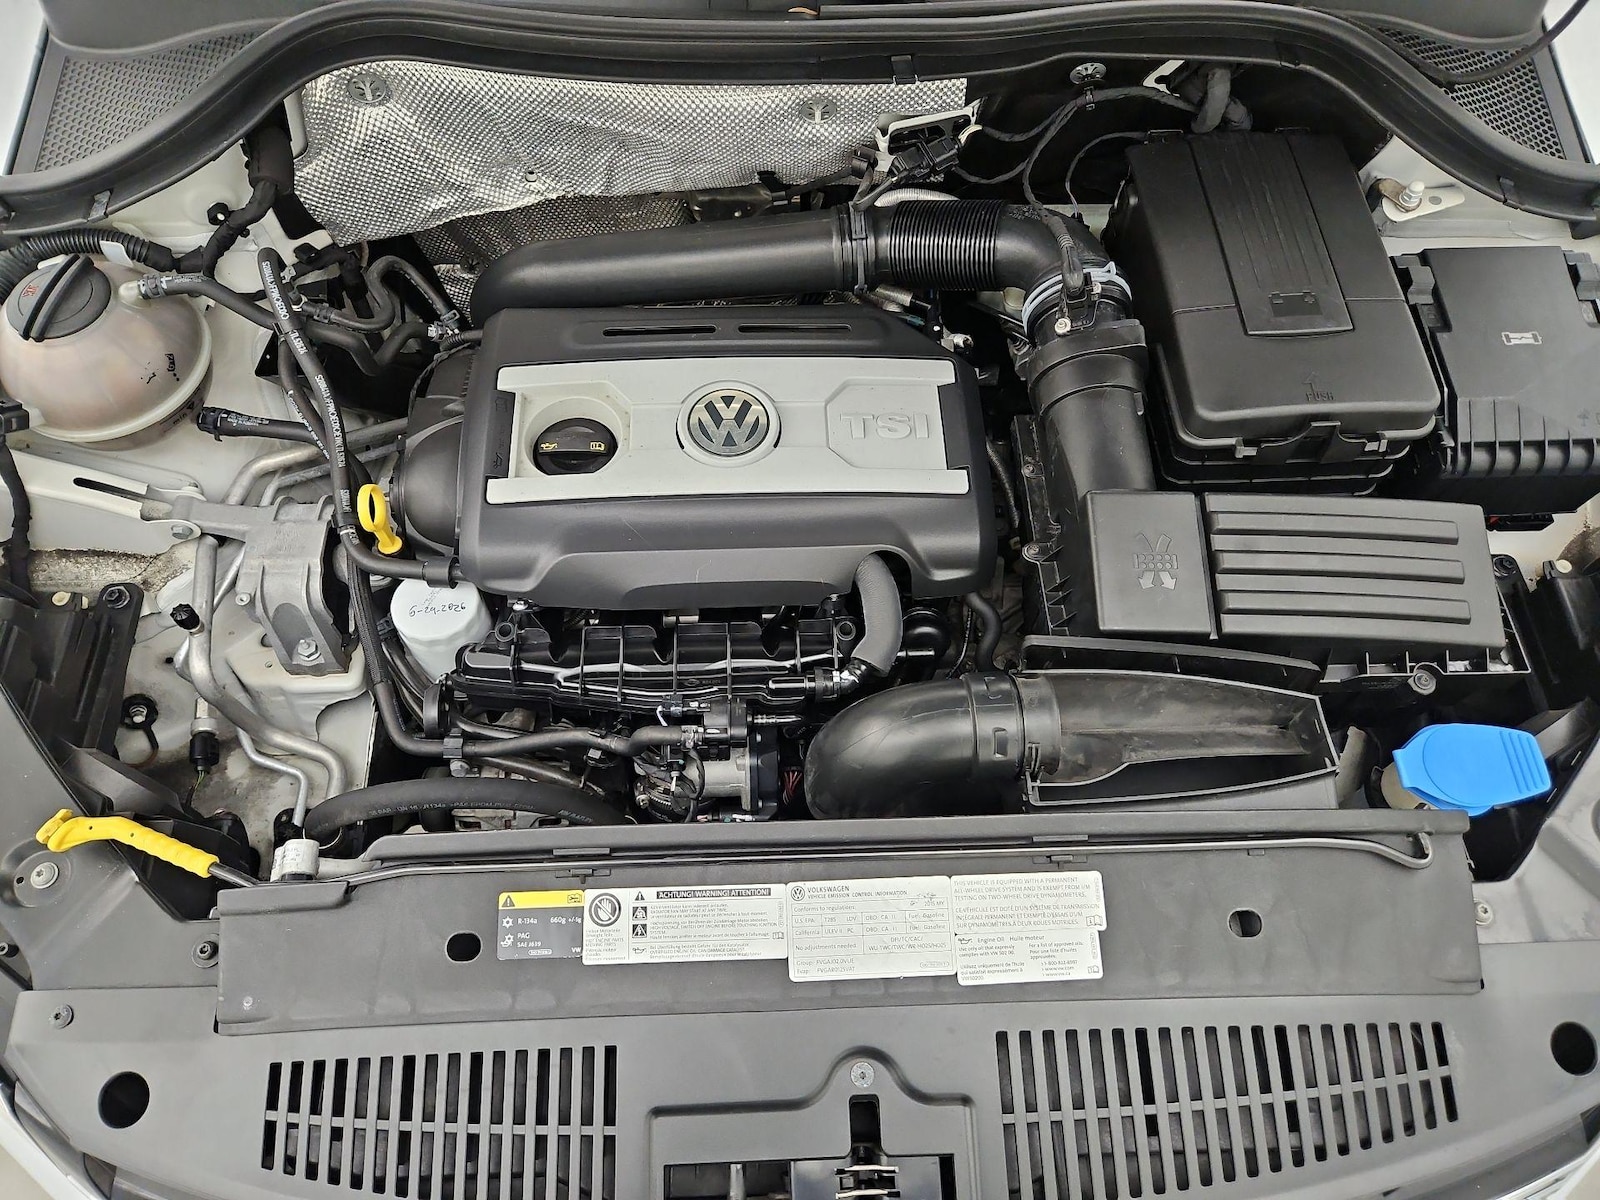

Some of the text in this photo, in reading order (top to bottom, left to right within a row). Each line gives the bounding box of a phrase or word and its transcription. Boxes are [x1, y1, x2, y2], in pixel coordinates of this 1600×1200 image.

[839, 411, 931, 440] TSI
[659, 888, 769, 899] ACHTUNG! WARNING! ATTENTION!
[517, 917, 538, 925] R-134a
[550, 916, 567, 925] 660g
[977, 937, 996, 945] Engine
[804, 944, 836, 952] adjustments
